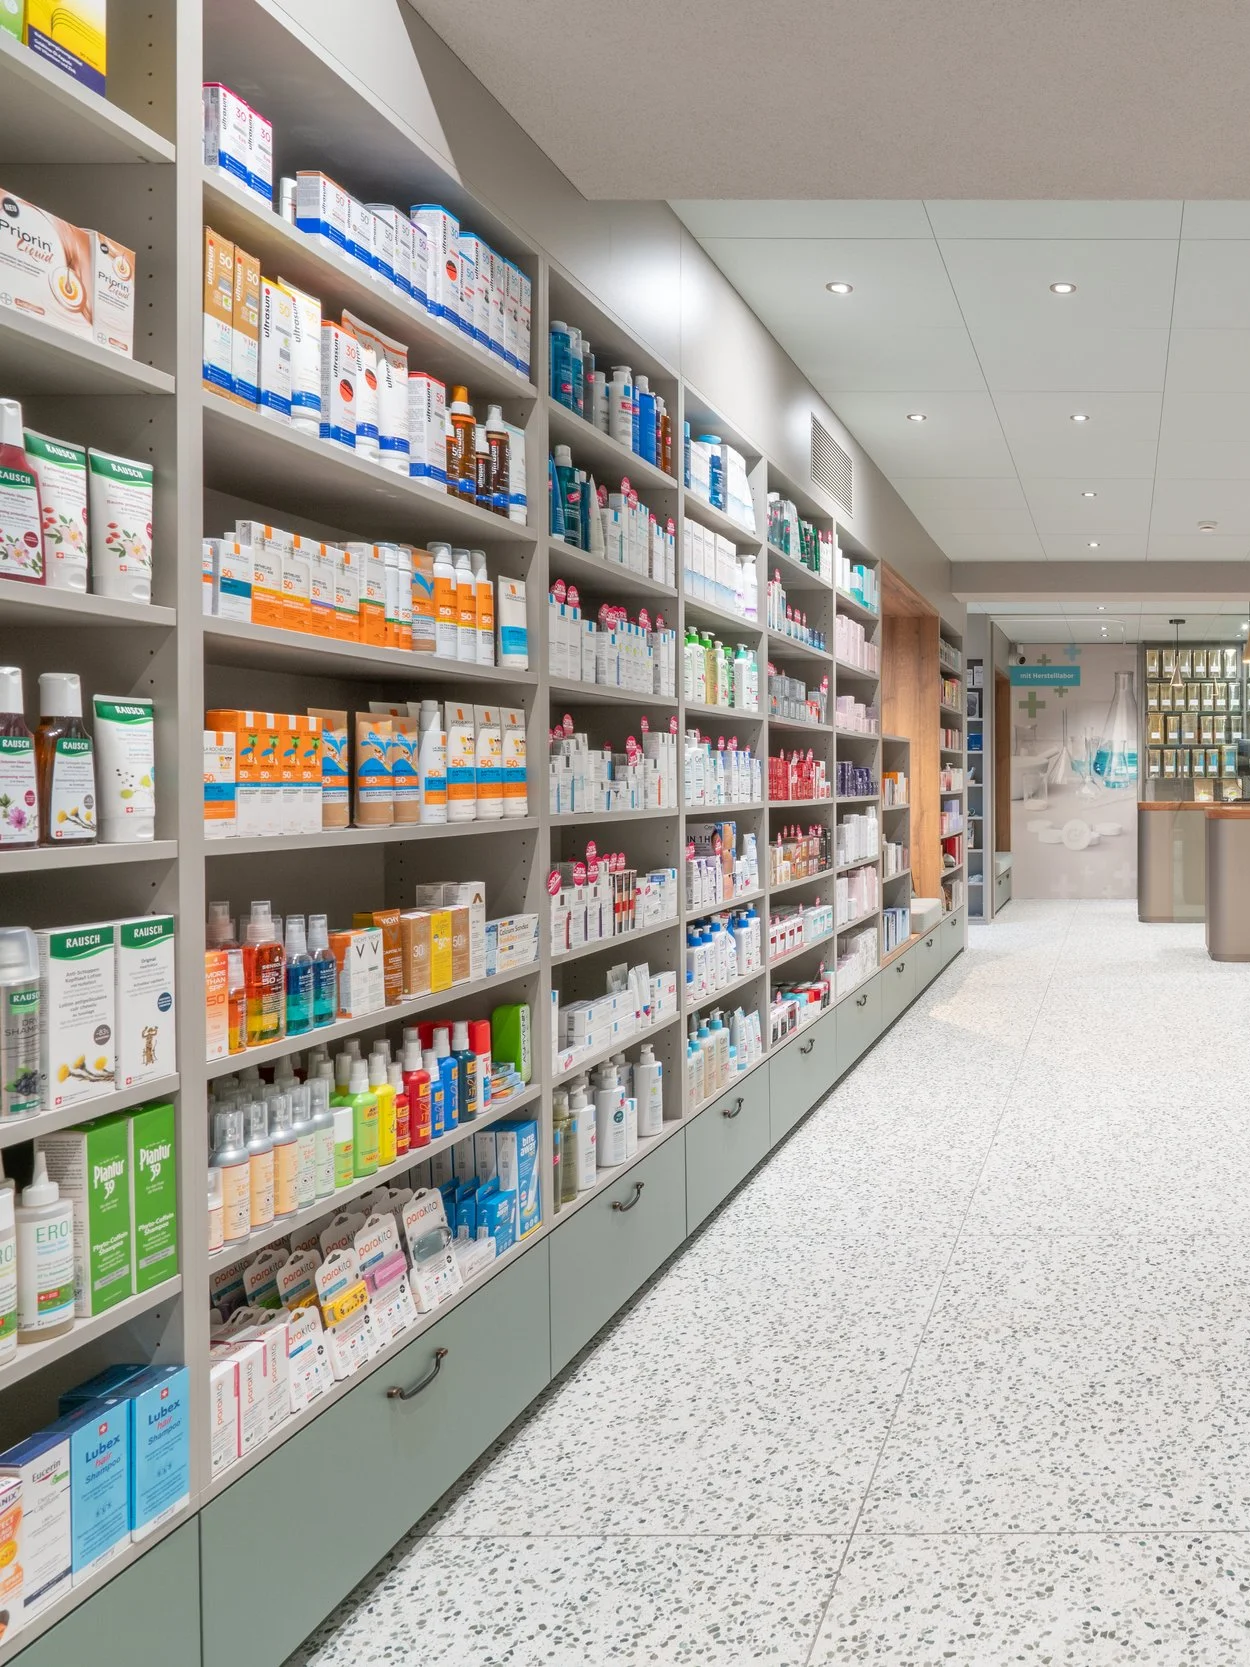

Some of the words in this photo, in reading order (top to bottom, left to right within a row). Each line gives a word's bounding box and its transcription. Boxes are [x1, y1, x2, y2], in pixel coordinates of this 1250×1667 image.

[236, 107, 247, 123] 30
[260, 128, 271, 143] 30
[4, 202, 18, 213] NEU
[335, 192, 345, 207] 50
[360, 211, 370, 225] 50
[0, 217, 52, 253] Priorin
[16, 236, 55, 264] Liquid
[219, 252, 233, 270] 50
[98, 271, 129, 293] Priorin
[246, 270, 259, 287] 50
[264, 295, 272, 339] ultrasun
[278, 302, 291, 319] 50
[292, 302, 301, 344] ultrasun
[345, 344, 357, 360] 30
[45, 443, 78, 462] RAUSCH
[491, 445, 499, 475] ultrasun
[110, 463, 145, 480] RAUSCH
[114, 705, 145, 716] RAUSCH
[2, 739, 30, 749] RAUSCH
[62, 741, 89, 751] RAUSCH
[380, 915, 399, 926] VICHY
[133, 925, 163, 939] RAUSCH
[66, 934, 101, 949] RAUSCH
[206, 969, 227, 980] MORE
[206, 976, 226, 986] THAN
[13, 991, 39, 1003] RAUSC
[206, 993, 226, 1007] 50
[522, 1133, 535, 1147] bite
[139, 1143, 172, 1172] Plantur
[520, 1141, 536, 1157] away
[93, 1159, 125, 1190] Plantur
[149, 1162, 161, 1182] 39
[103, 1179, 116, 1200] 39
[406, 1201, 439, 1228] parakito
[144, 1221, 170, 1237] Shampoo
[98, 1240, 124, 1257] Shampoo
[358, 1228, 393, 1258] parakito
[214, 1259, 250, 1288] parakito
[249, 1258, 285, 1287] parakito
[282, 1259, 316, 1288] parakito
[320, 1258, 352, 1288] parakito
[287, 1321, 316, 1346] arakito
[147, 1399, 181, 1426] Lubex
[156, 1414, 173, 1431] hair
[147, 1420, 182, 1447] Shampoo
[85, 1433, 121, 1464] Lubex
[94, 1451, 113, 1468] hair
[32, 1459, 62, 1483] Eucerin
[85, 1456, 122, 1485] Shampoo
[0, 1491, 17, 1508] NIX
